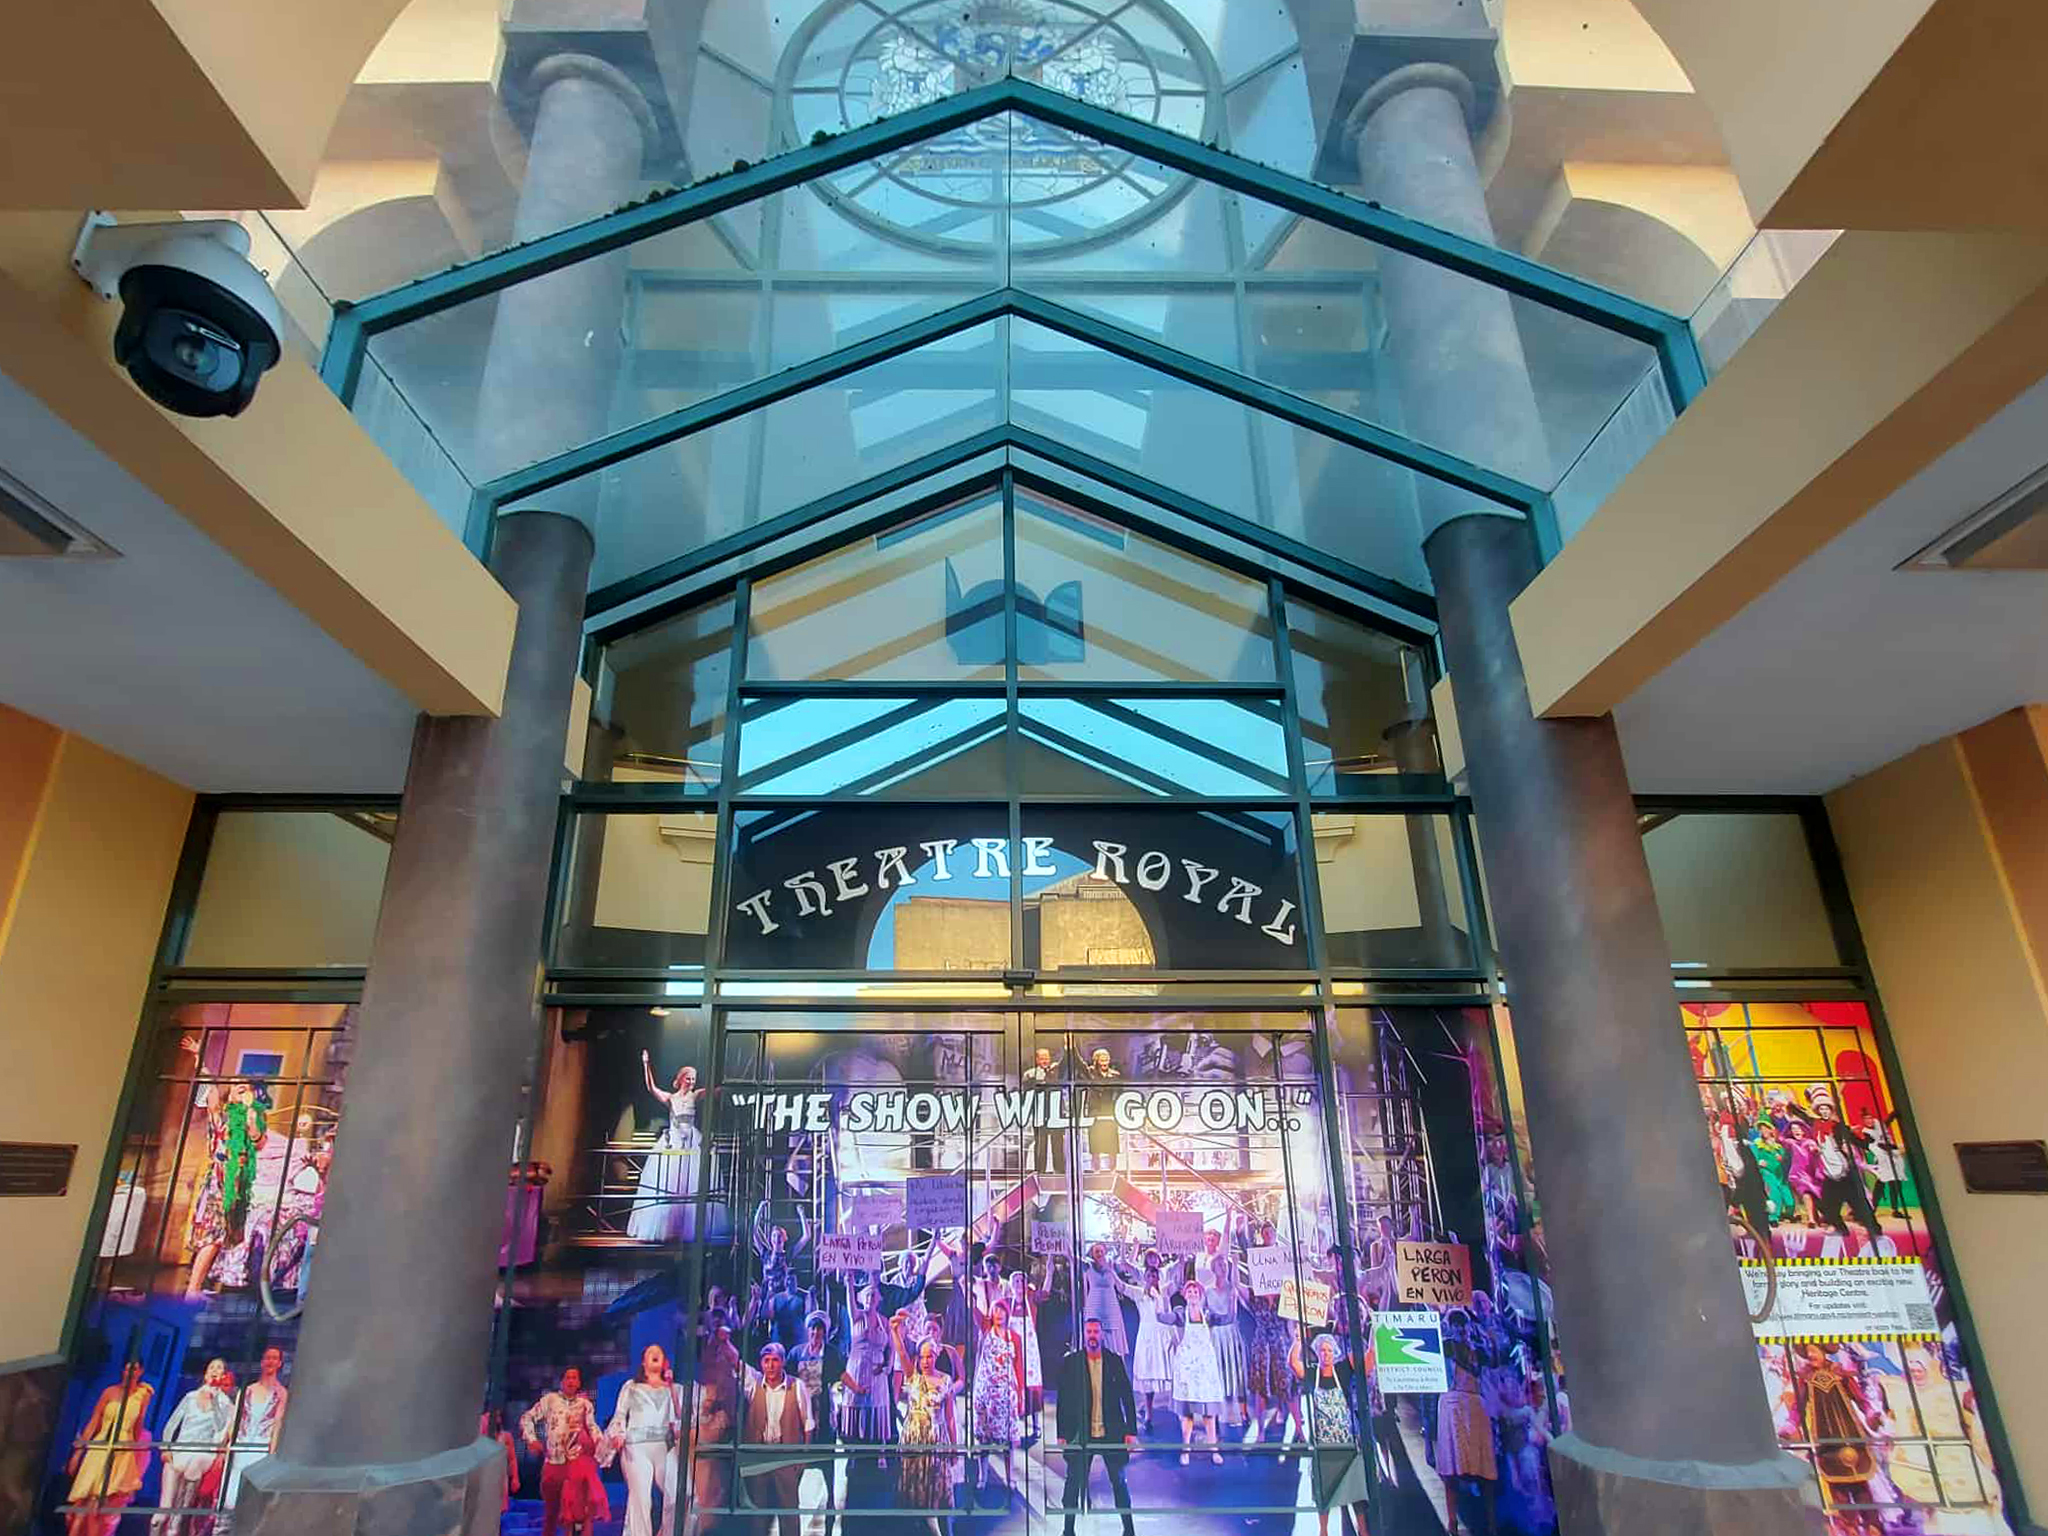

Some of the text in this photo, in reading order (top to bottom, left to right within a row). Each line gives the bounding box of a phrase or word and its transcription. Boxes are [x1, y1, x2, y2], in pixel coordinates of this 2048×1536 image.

[737, 836, 1301, 945] THEATRE ROYAL
[846, 1090, 981, 1133] SHOW
[993, 1089, 1095, 1130] WILL
[1114, 1090, 1185, 1131] GO
[823, 1235, 851, 1250] LARGA
[822, 1251, 836, 1264] EN
[843, 1252, 865, 1265] VIVO
[1404, 1247, 1451, 1265] LARGA
[1411, 1266, 1463, 1286] PERON
[1838, 1267, 1871, 1277] Theatre
[1890, 1267, 1900, 1276] to
[1800, 1278, 1817, 1288] and
[1818, 1278, 1852, 1289] building
[1406, 1287, 1465, 1303] EN VIVO
[1801, 1288, 1839, 1300] Heritage
[1808, 1302, 1821, 1310] For
[1822, 1302, 1851, 1311] updates
[1374, 1313, 1438, 1323] TIMARU
